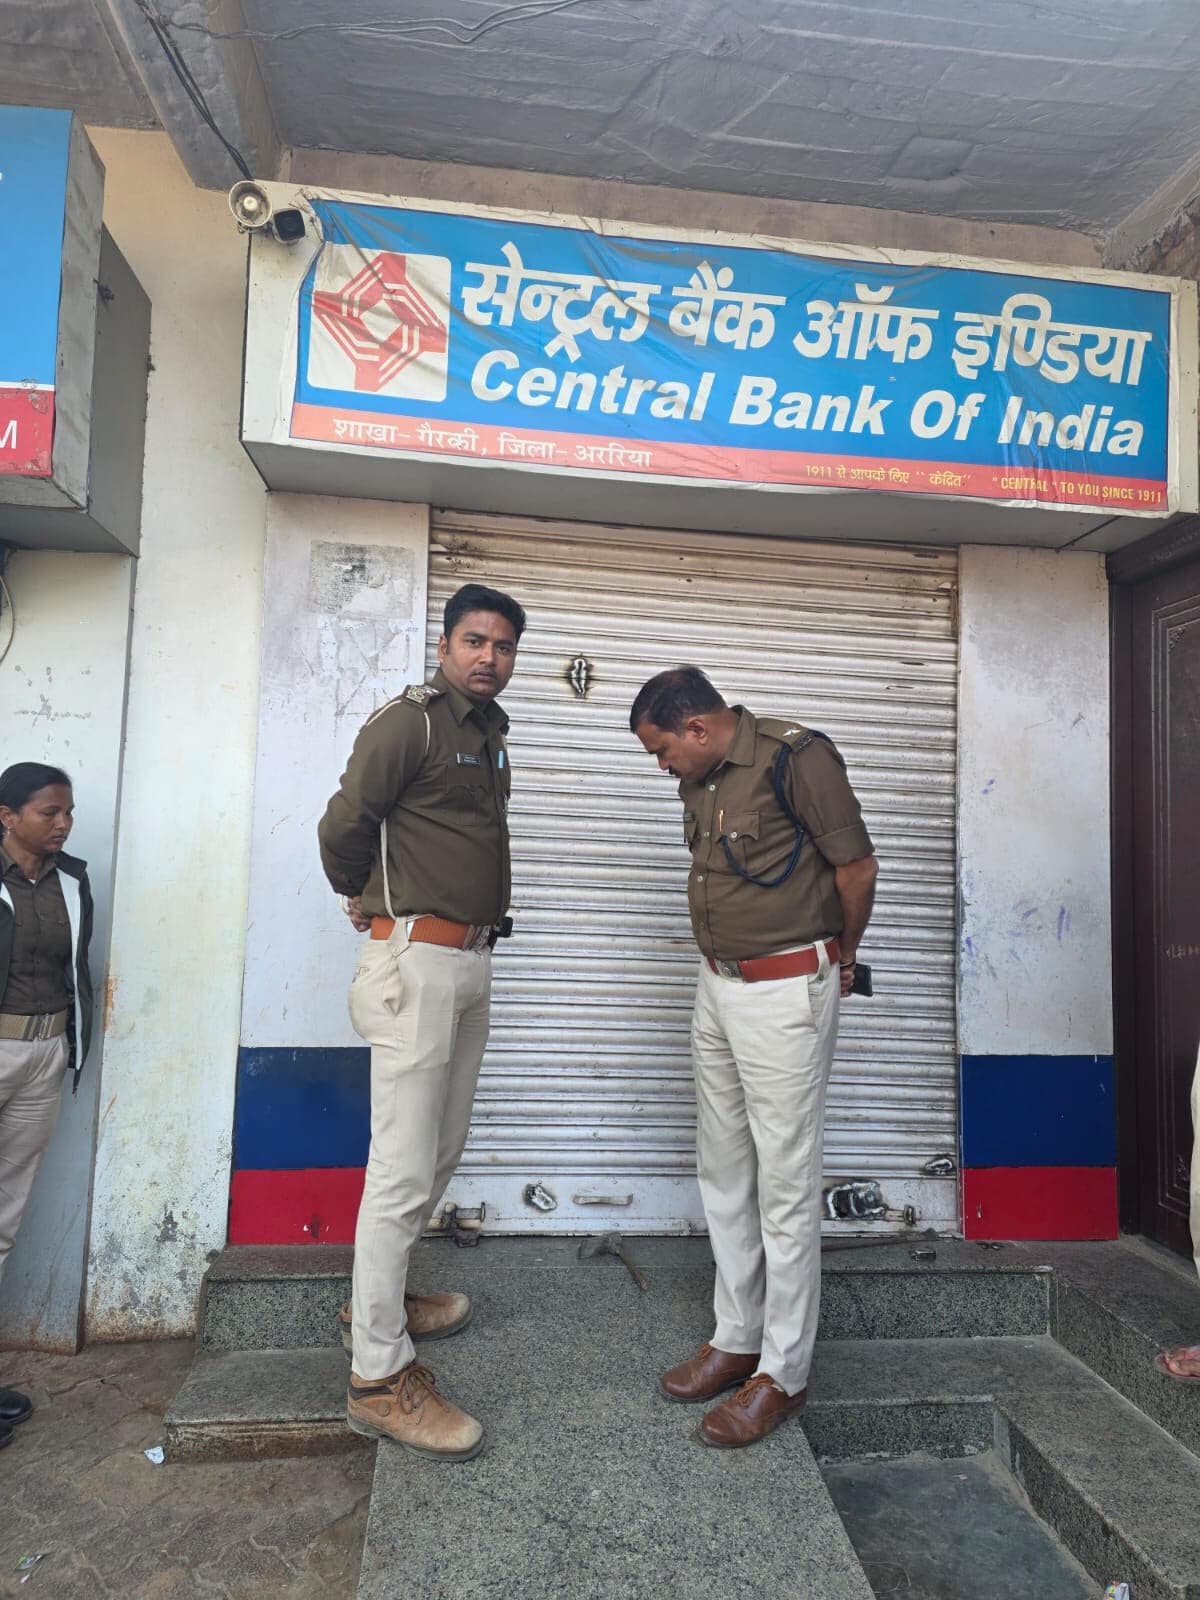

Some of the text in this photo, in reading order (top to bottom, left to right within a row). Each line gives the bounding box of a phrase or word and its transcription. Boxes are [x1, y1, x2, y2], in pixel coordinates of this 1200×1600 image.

[461, 241, 1152, 386] सेन्ट्रल बैंक ऑफ इण्डिया
[470, 350, 1145, 458] Central Bank Of India
[574, 442, 653, 467] अररिया
[806, 465, 832, 478] 1911
[850, 466, 886, 482] आपके
[888, 467, 911, 484] लिए
[1060, 481, 1075, 495] TO
[1078, 482, 1100, 497] YOU
[1102, 485, 1135, 500] SINCE
[1138, 489, 1162, 503] 1911
